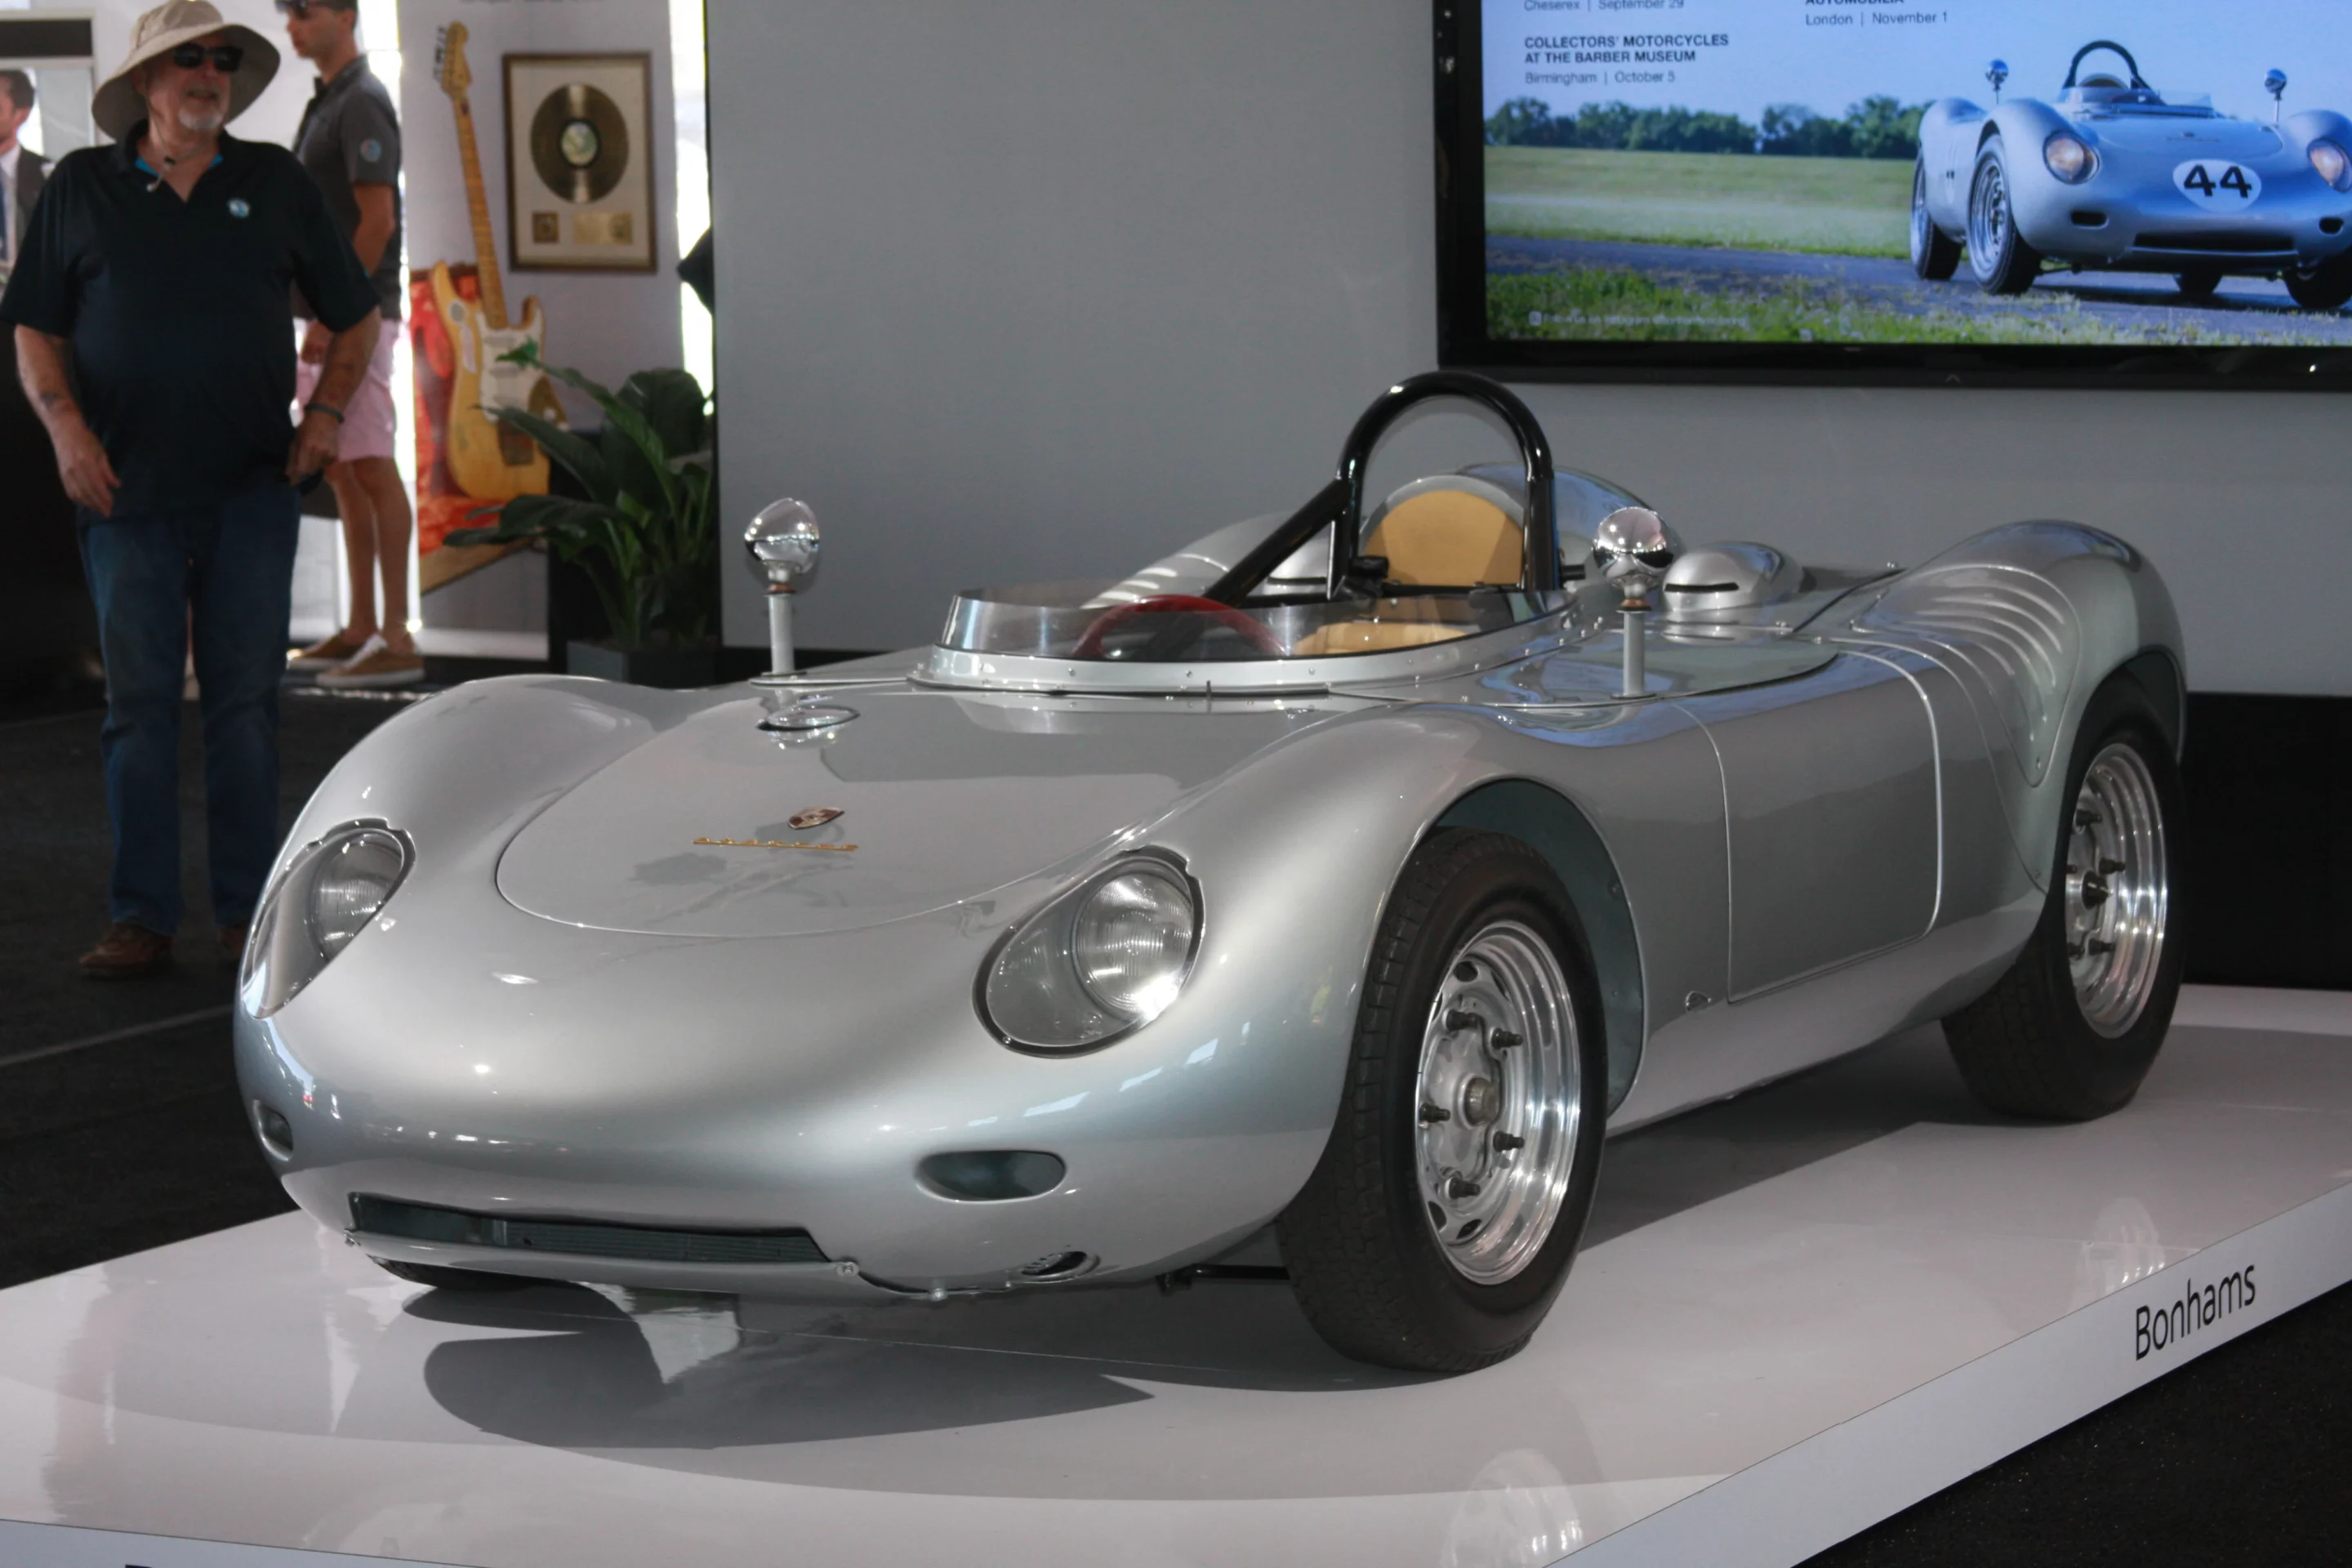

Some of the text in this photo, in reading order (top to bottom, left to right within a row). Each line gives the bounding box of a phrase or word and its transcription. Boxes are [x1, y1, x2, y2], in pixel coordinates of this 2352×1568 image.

[1598, 0, 1664, 12] September
[1668, 0, 1685, 9] 29
[1805, 13, 1853, 26] London
[1872, 11, 1937, 24] November
[1942, 11, 1948, 23] 1
[1623, 33, 1730, 47] MOTORCYCLES
[1525, 50, 1696, 64] AT THE BARBER MUSEUM
[1525, 71, 1597, 86] Birmingham
[1614, 70, 1664, 82] October
[1668, 70, 1676, 82] 5
[2184, 164, 2252, 198] 44
[2136, 1264, 2255, 1361] Bonhams
